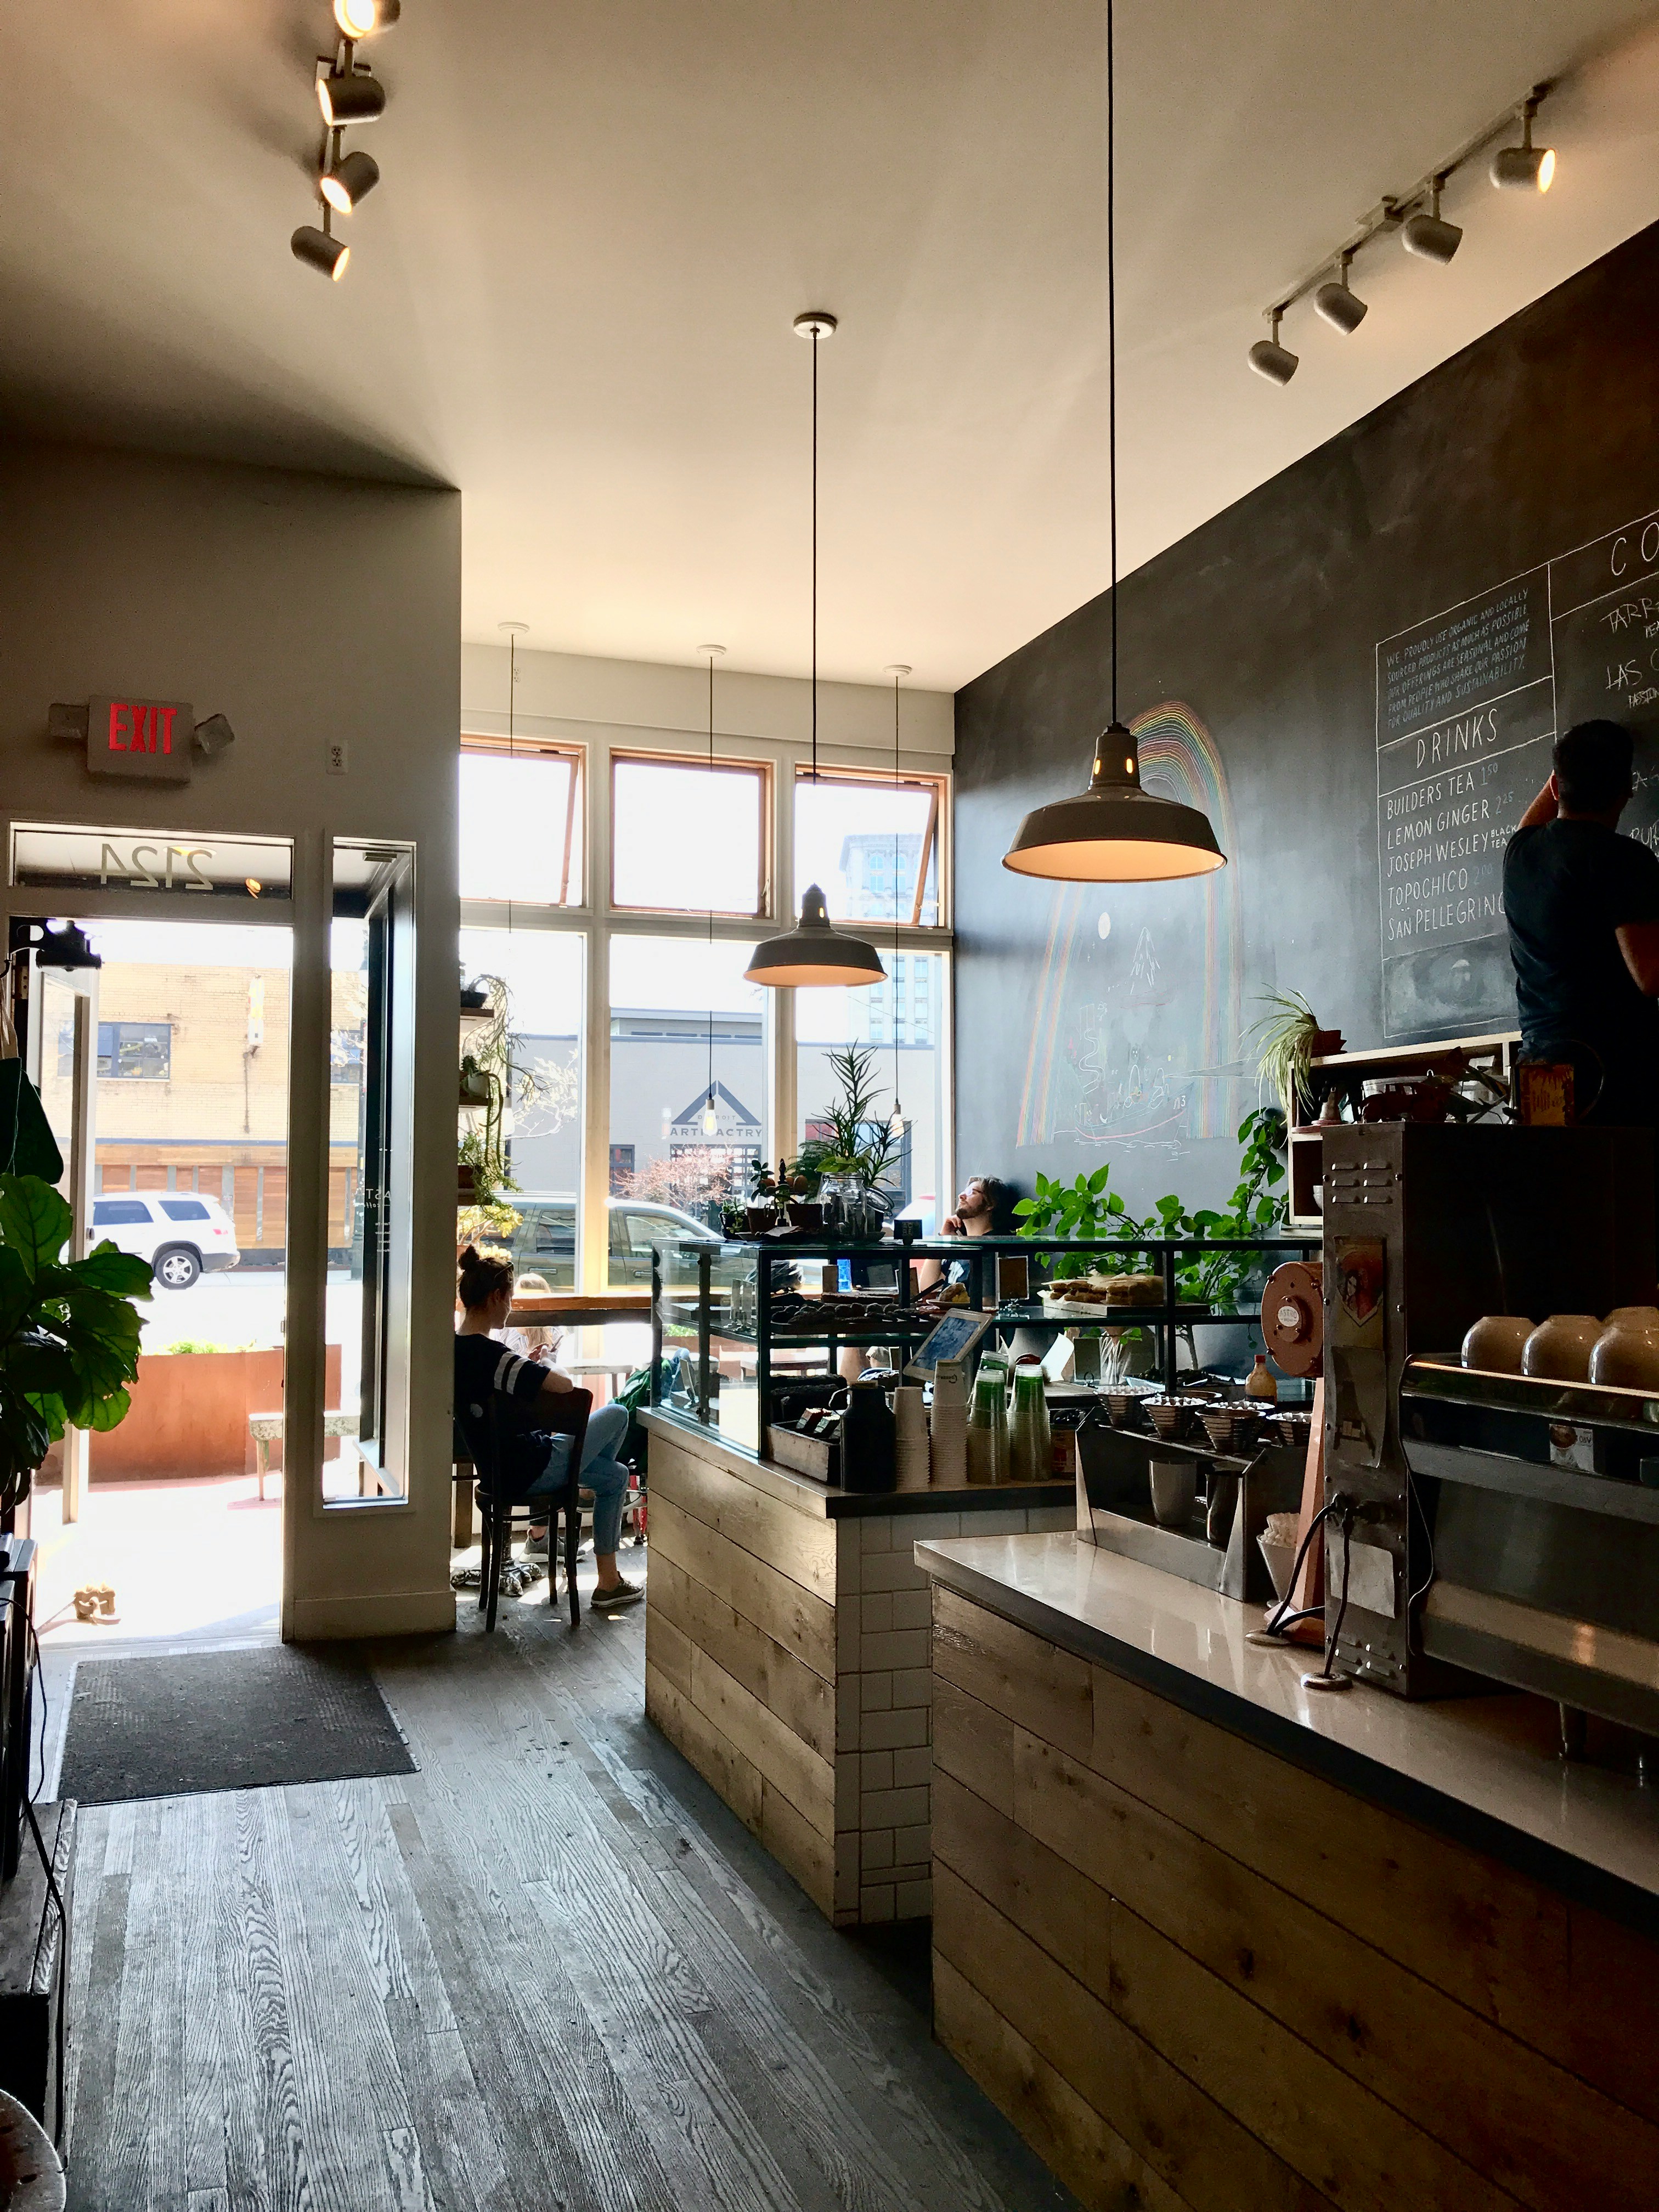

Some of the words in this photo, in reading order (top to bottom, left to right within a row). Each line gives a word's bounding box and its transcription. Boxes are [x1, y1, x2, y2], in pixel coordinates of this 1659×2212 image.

[1387, 651, 1400, 668] WE
[1404, 637, 1434, 660] PROUDLY
[1435, 629, 1448, 644] USE
[1448, 614, 1478, 637] ORGANIC
[1481, 607, 1494, 620] AND
[1496, 587, 1528, 612] LOCALLY
[1599, 597, 1659, 634] TARR
[1387, 662, 1417, 685] SOURCED
[1418, 644, 1450, 670] PRODUCTS
[1452, 639, 1460, 652] AS
[1461, 629, 1480, 646] MUCH
[1481, 623, 1490, 637] AS
[1387, 685, 1400, 701] OUR
[1402, 663, 1441, 693] OFFERINGS
[1442, 656, 1455, 672] ARE
[1456, 639, 1492, 667] SEASONAL
[1494, 633, 1508, 647] AND
[1510, 618, 1530, 640] COME
[1389, 698, 1406, 714] FROM
[1408, 684, 1432, 707] PEOPLE
[1435, 676, 1449, 692] WHO
[1451, 664, 1472, 685] SHARE
[1475, 657, 1488, 673] OUR
[1491, 636, 1527, 665] PASSION
[1605, 659, 1643, 691] LAS
[109, 703, 177, 755] EXIT
[1388, 715, 1400, 729] FOR
[1402, 698, 1435, 723] QUALITY
[1436, 691, 1452, 707] AND
[1417, 708, 1498, 769] DRINKS
[1387, 783, 1442, 820] BUILDERS
[1448, 771, 1475, 797] TEA
[1387, 817, 1432, 850] LEMON
[1437, 799, 1490, 832] GINGER
[1491, 824, 1518, 838] BLACK
[1491, 837, 1508, 849] TEA
[1387, 845, 1432, 878] JOSEPH
[1436, 831, 1489, 862] WESLEY
[1388, 917, 1412, 941] SAN
[670, 1127, 762, 1137] ARTIACTRY
